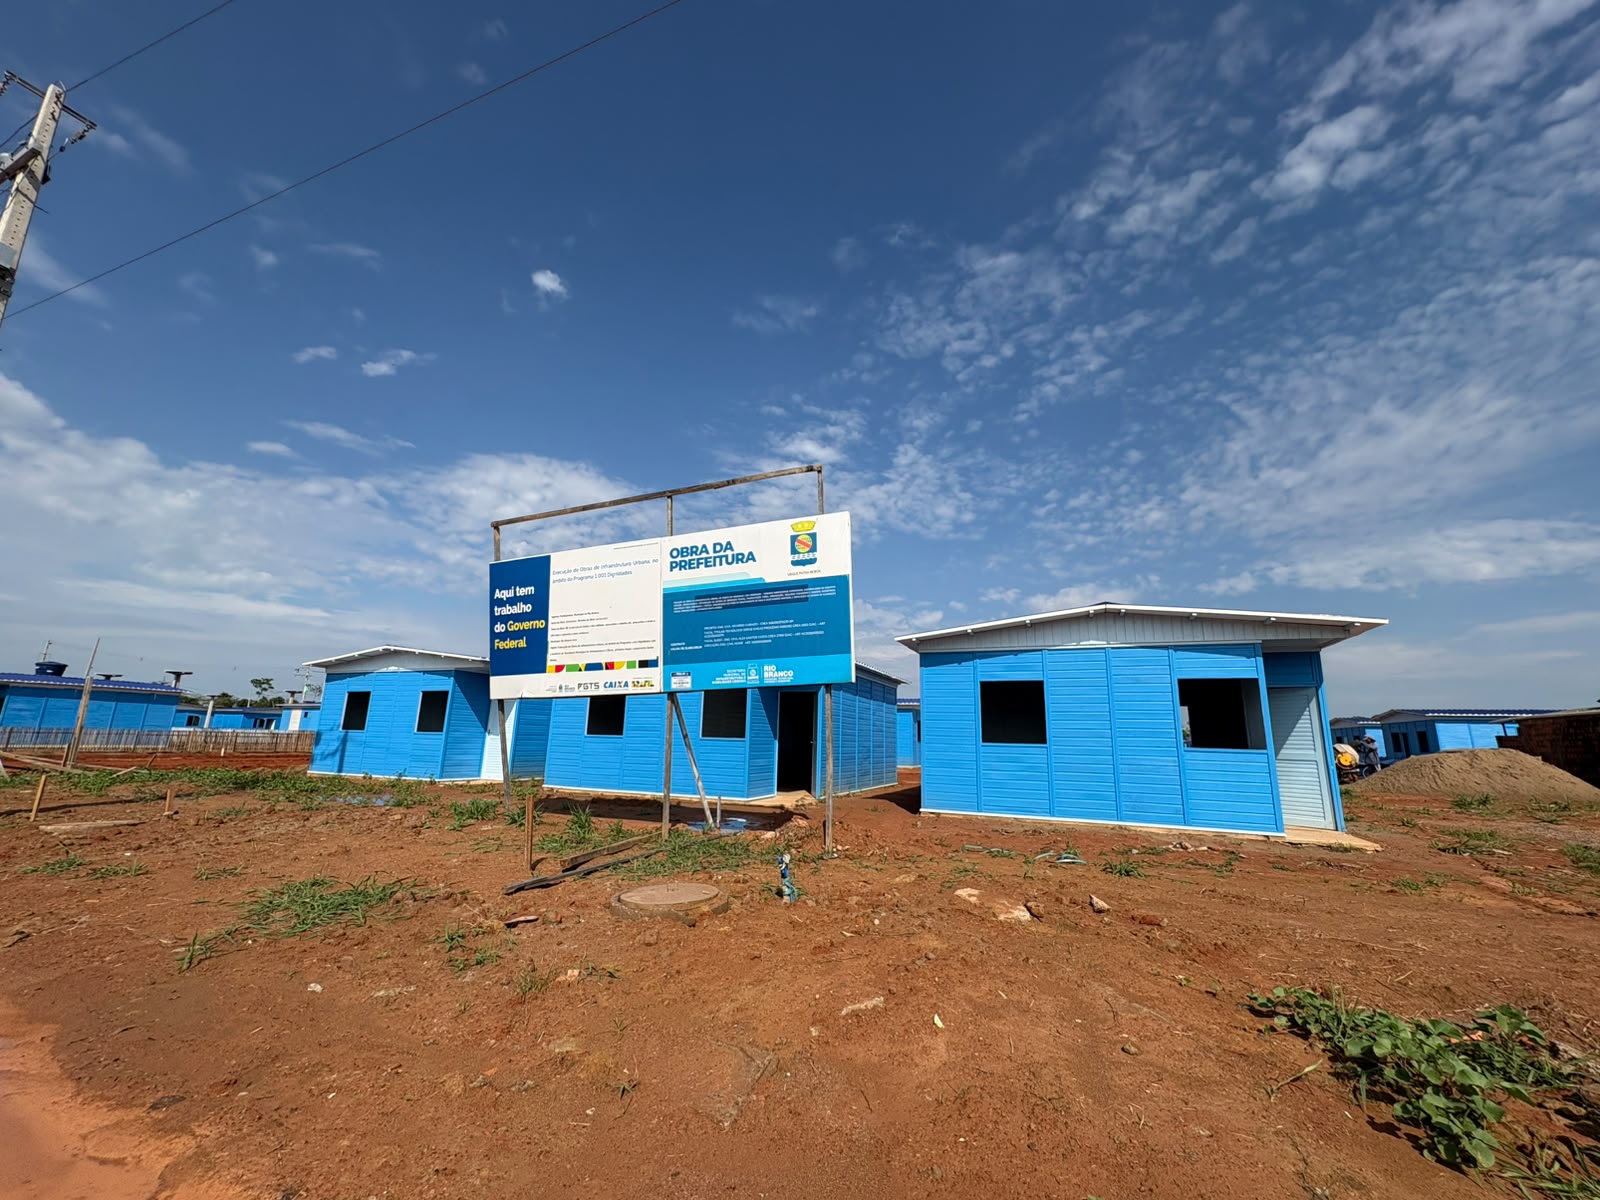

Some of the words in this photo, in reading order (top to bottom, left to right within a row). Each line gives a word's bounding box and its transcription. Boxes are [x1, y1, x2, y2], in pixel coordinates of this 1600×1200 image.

[669, 544, 711, 559] OBRA
[713, 541, 734, 552] DA
[669, 551, 756, 572] PREFEITURA
[494, 586, 515, 600] Aqui
[515, 585, 535, 597] tem
[494, 601, 532, 616] trabalho
[494, 621, 505, 633] do
[507, 619, 546, 632] Governo
[494, 636, 527, 650] Federal
[764, 670, 793, 678] BRANCO
[603, 680, 629, 689] CAIXA
